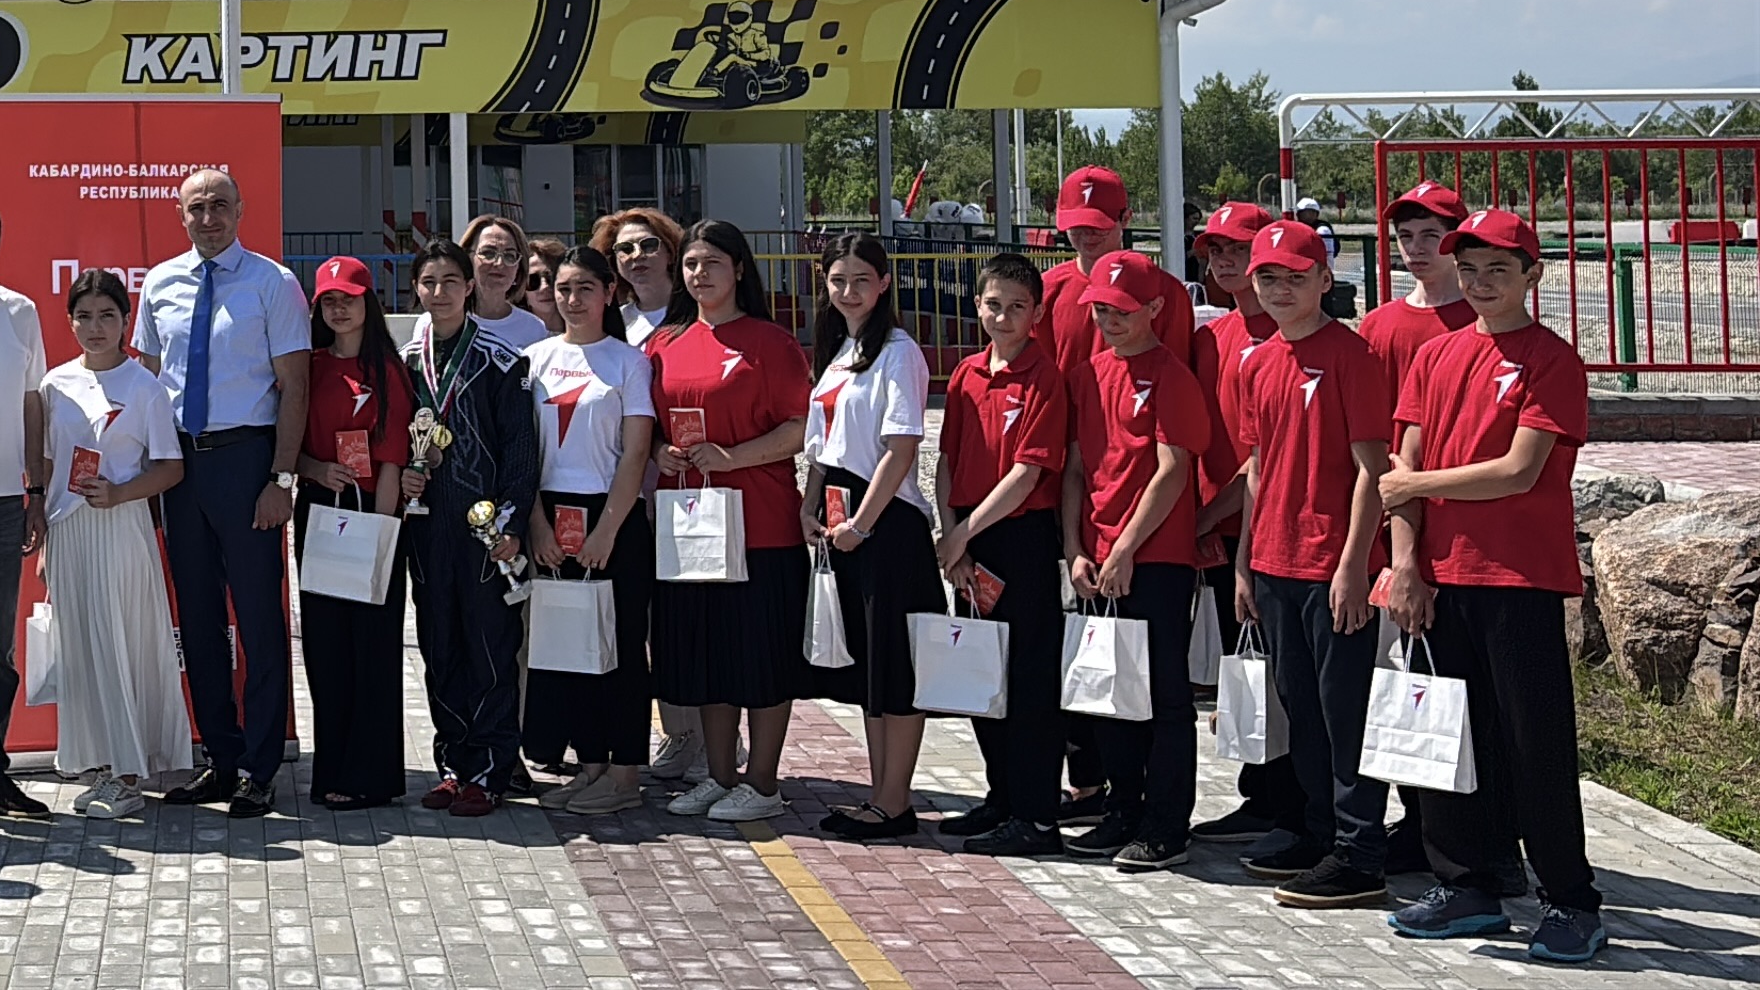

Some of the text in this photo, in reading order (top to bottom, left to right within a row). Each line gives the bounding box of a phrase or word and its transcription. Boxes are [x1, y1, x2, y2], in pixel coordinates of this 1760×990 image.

[122, 29, 448, 84] КАРТИНГ
[29, 163, 229, 179] КАБАРДИНО-БАЛКАРСЯ
[79, 186, 180, 200] РЕСПУБЛИКА
